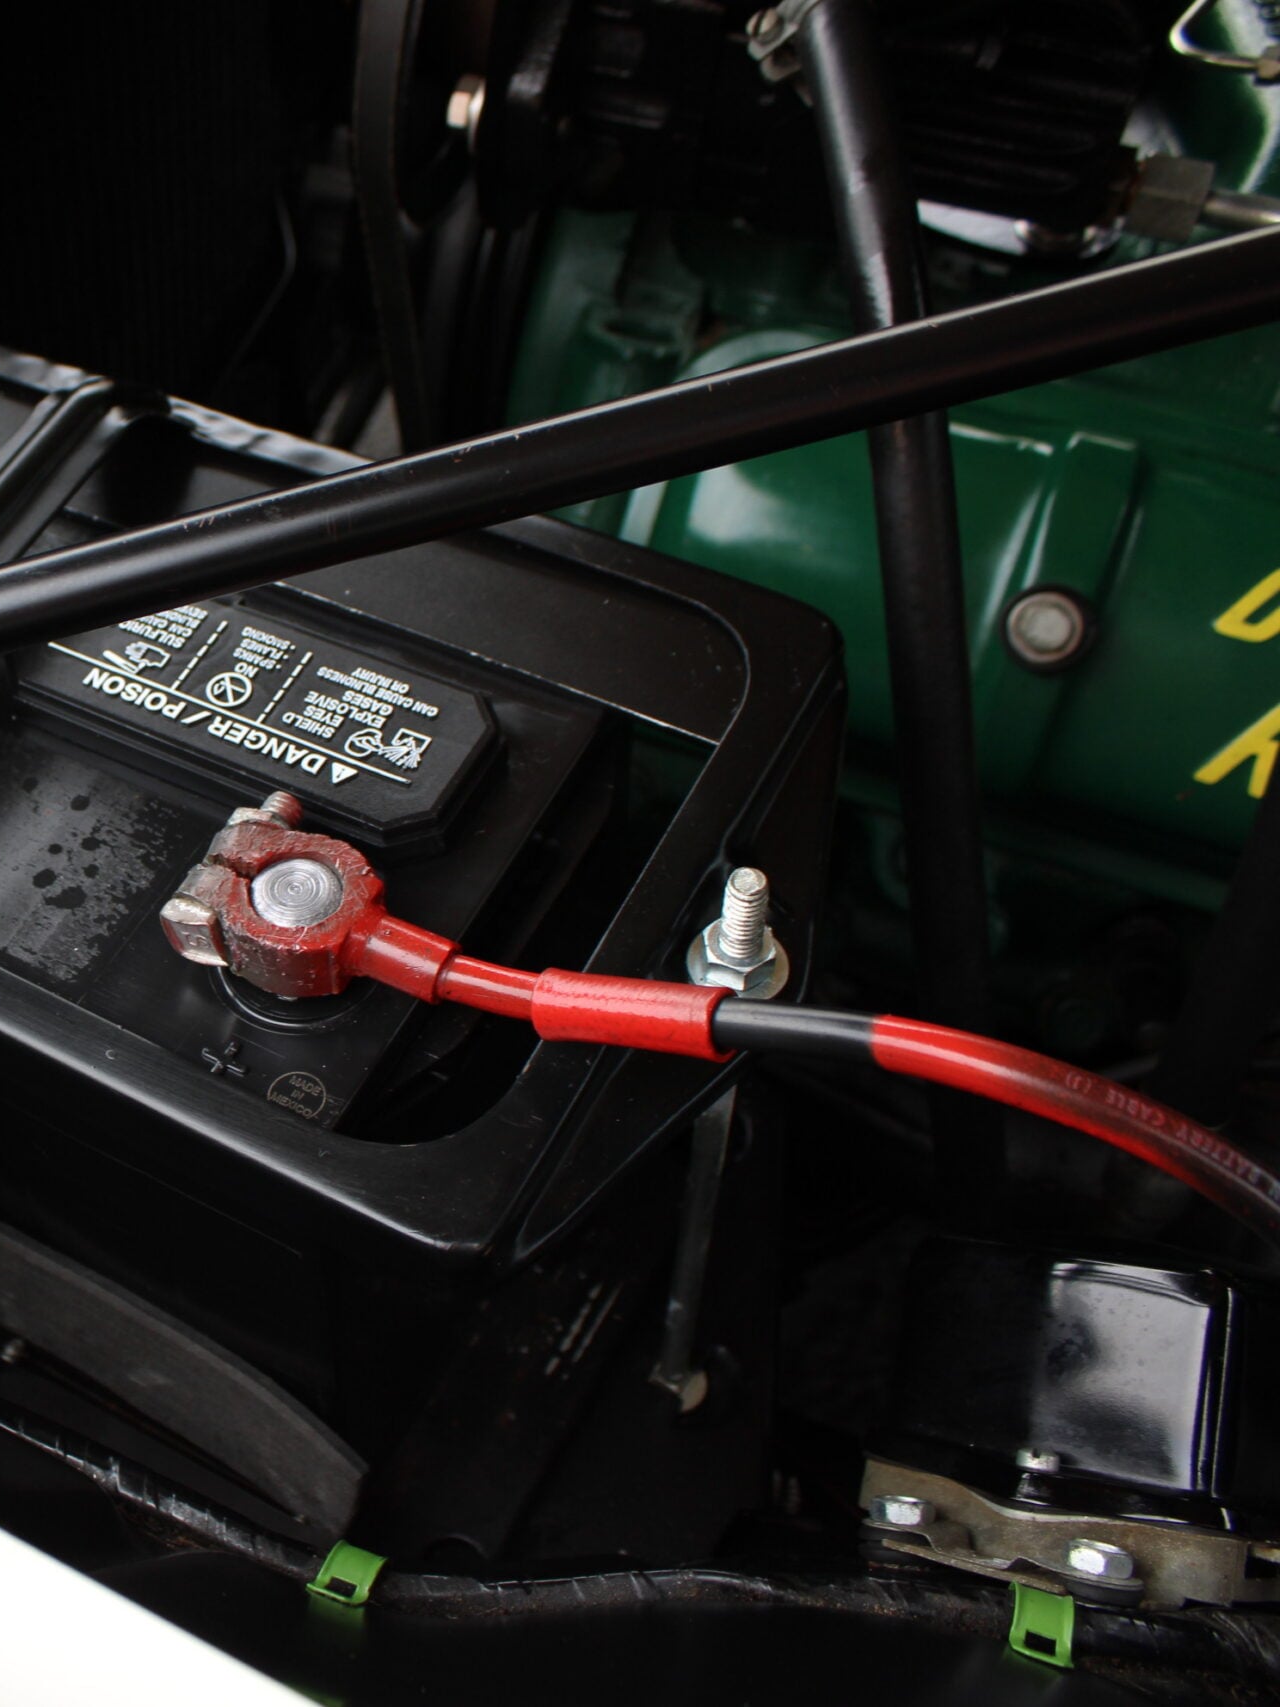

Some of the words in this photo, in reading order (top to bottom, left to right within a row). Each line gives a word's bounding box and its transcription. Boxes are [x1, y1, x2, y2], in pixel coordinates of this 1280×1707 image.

[168, 623, 193, 638] CAN
[241, 626, 291, 650] SMOKING
[233, 646, 276, 669] SPARKS
[240, 638, 283, 659] FLAMES
[234, 662, 259, 678] NO
[318, 666, 379, 695] BLINDNESS
[351, 667, 393, 689] INJURY
[83, 668, 186, 718] POISON
[375, 686, 414, 708] CAUSE
[390, 681, 409, 694] OR
[305, 691, 386, 728] EXPLOSIVE
[342, 690, 393, 715] GASES
[413, 701, 438, 716] CAN
[283, 712, 335, 738] SHIELD
[304, 705, 344, 727] EYES
[208, 716, 328, 774] DANGER
[289, 1075, 321, 1097] MADE
[291, 1089, 306, 1101] IN
[270, 1091, 313, 1118] MEXICO
[1106, 1086, 1165, 1127] CABLE
[1176, 1121, 1261, 1185] BATTERY
